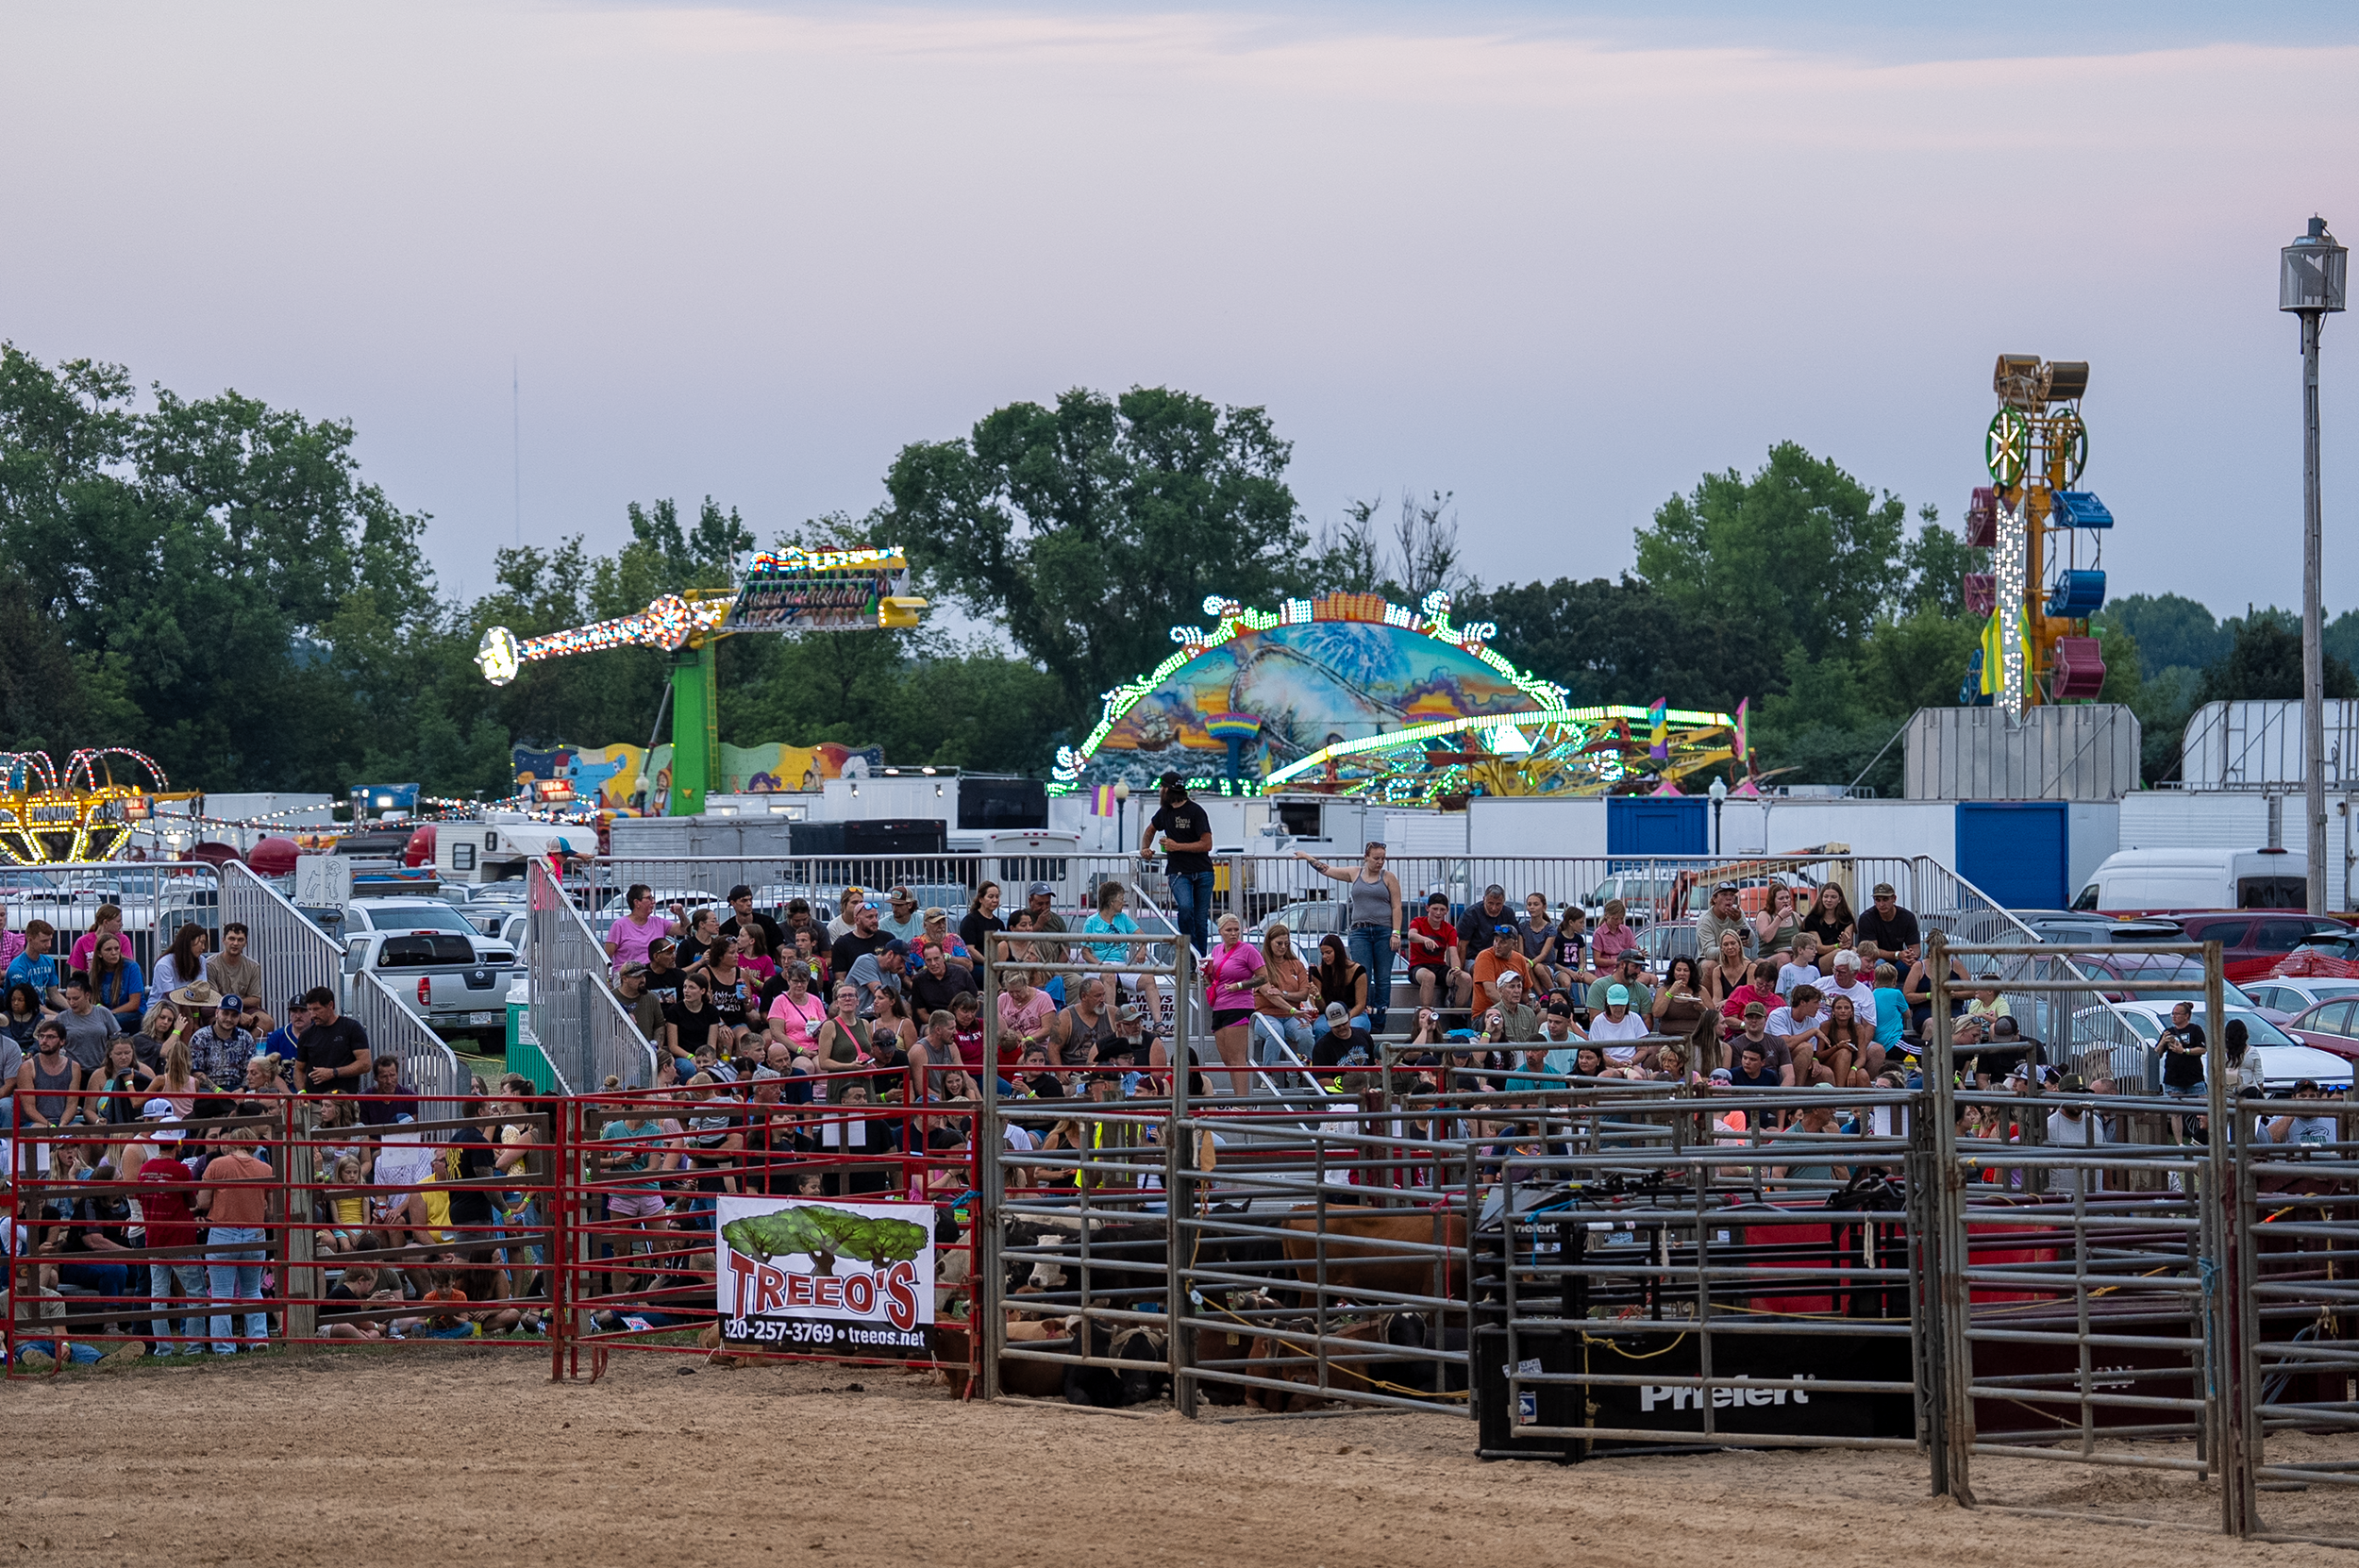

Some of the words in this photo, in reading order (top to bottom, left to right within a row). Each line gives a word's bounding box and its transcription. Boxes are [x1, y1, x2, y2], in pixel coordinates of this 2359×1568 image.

[31, 806, 76, 822] TORNADO
[728, 1248, 920, 1332] TREEO'S
[725, 1318, 834, 1343] 920-257-3769
[848, 1326, 925, 1347] treeos.net
